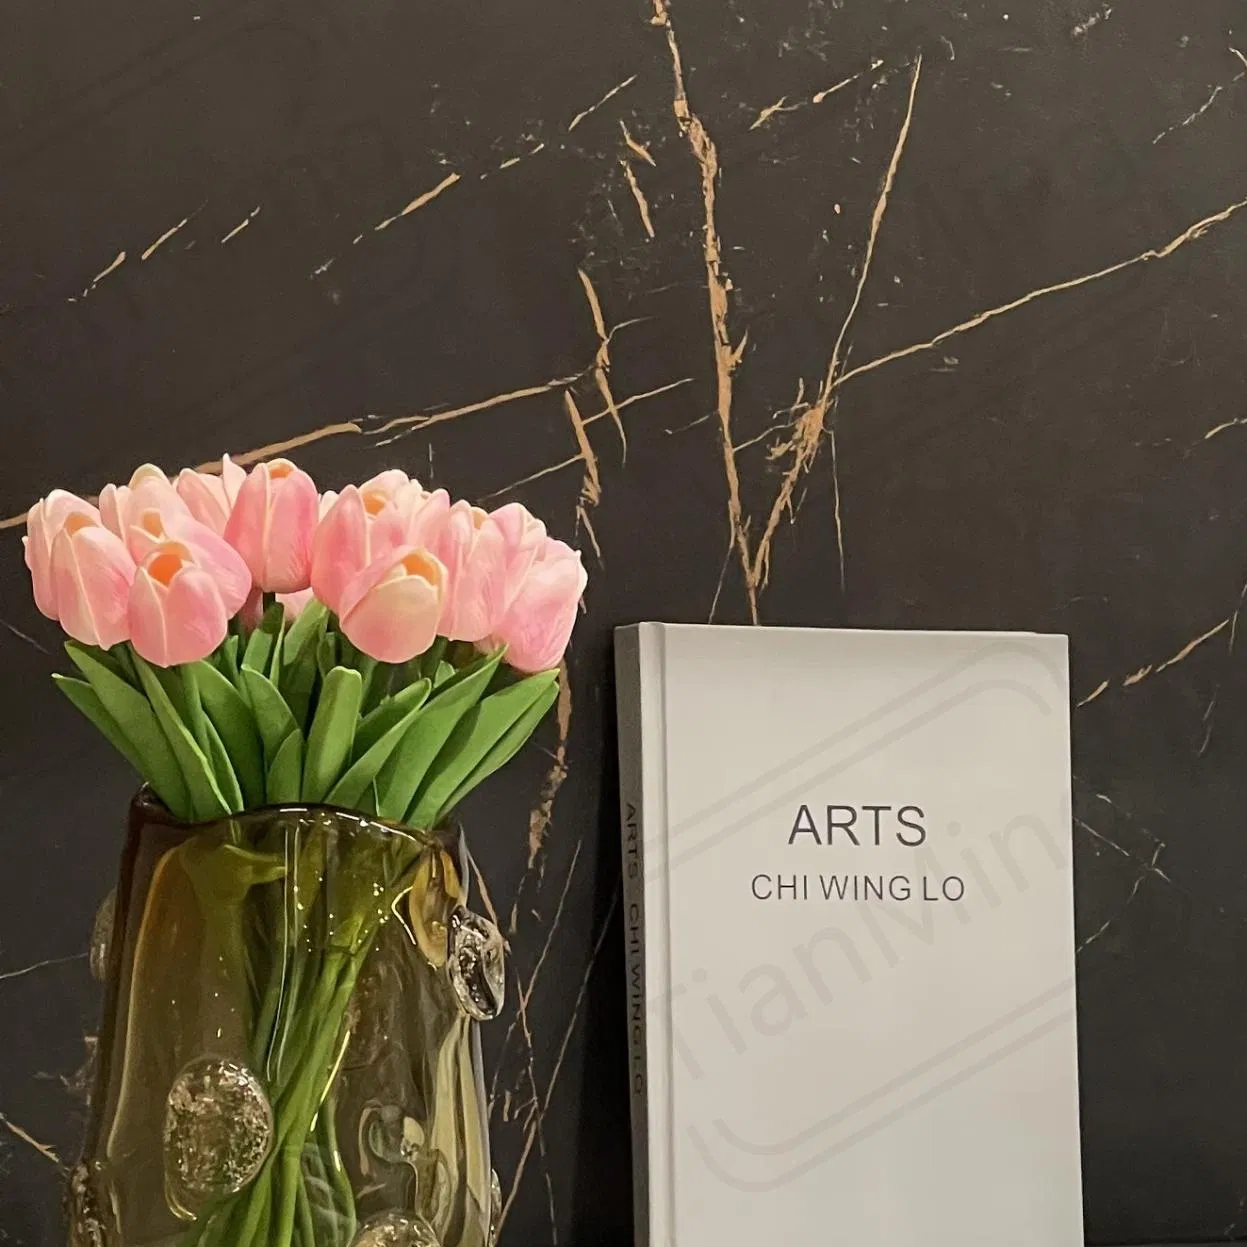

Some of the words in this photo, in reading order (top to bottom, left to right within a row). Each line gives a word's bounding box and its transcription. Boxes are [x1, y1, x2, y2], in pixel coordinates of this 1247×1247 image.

[626, 802, 640, 881] ARTS
[788, 803, 927, 847] ARTS
[751, 874, 808, 901] CHI
[819, 874, 912, 902] WING
[922, 875, 966, 902] LO
[628, 903, 640, 954] CHI
[630, 962, 642, 1046] WING
